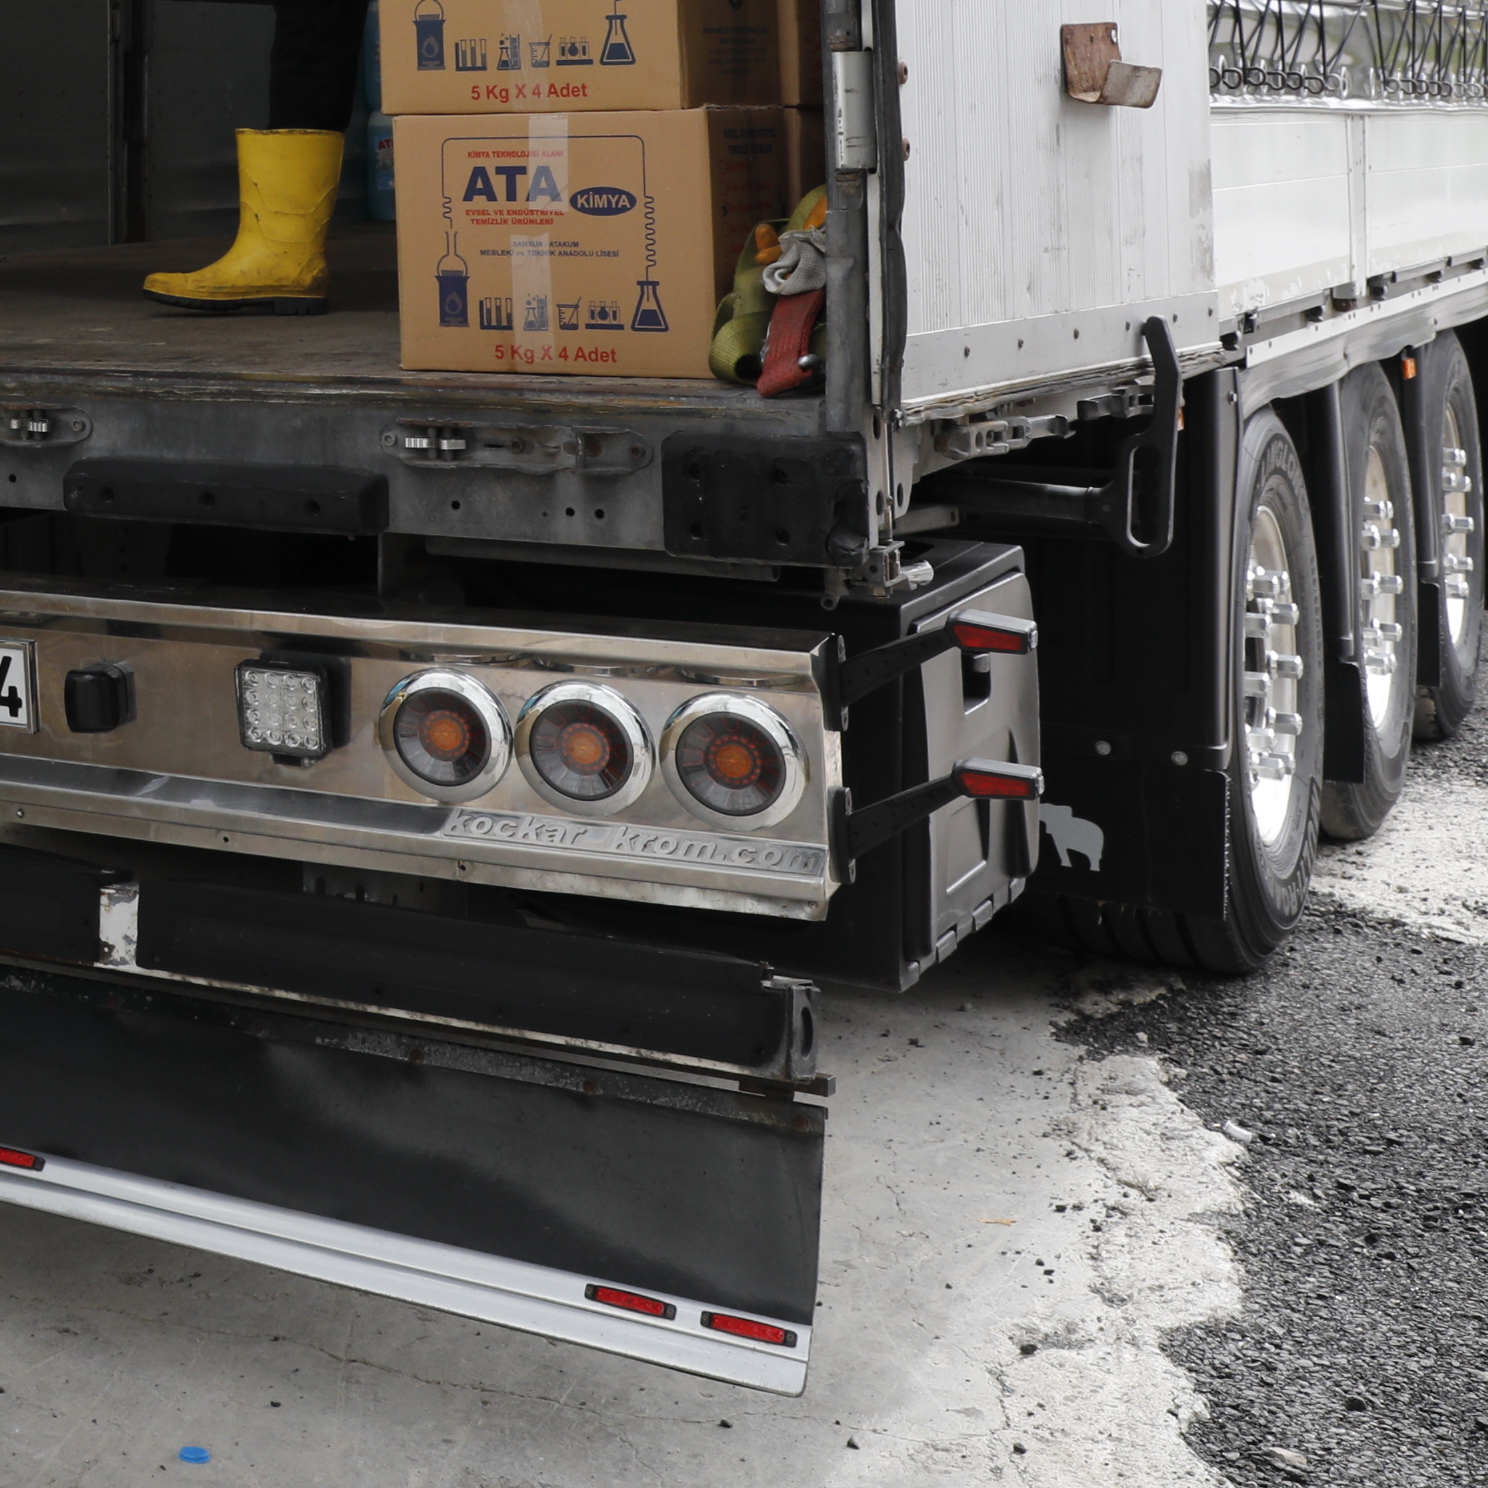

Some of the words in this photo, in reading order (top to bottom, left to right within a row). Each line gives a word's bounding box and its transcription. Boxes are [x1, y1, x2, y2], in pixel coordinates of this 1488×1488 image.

[471, 86, 481, 100] 5
[486, 84, 509, 103] Kg
[515, 84, 527, 99] X
[532, 84, 541, 98] 4
[547, 82, 588, 98] Adet
[467, 150, 491, 159] KİMYA
[462, 165, 563, 202] ATA
[577, 191, 631, 209] KİMYA
[471, 217, 509, 225] TEMİZLİK
[595, 249, 619, 258] LİSESİ
[494, 344, 504, 359] 5
[510, 344, 535, 364] Kg
[541, 345, 553, 360] X
[558, 346, 569, 361] 4
[574, 347, 617, 363] Adet
[444, 807, 587, 846] kockar
[612, 826, 824, 873] krom.com
